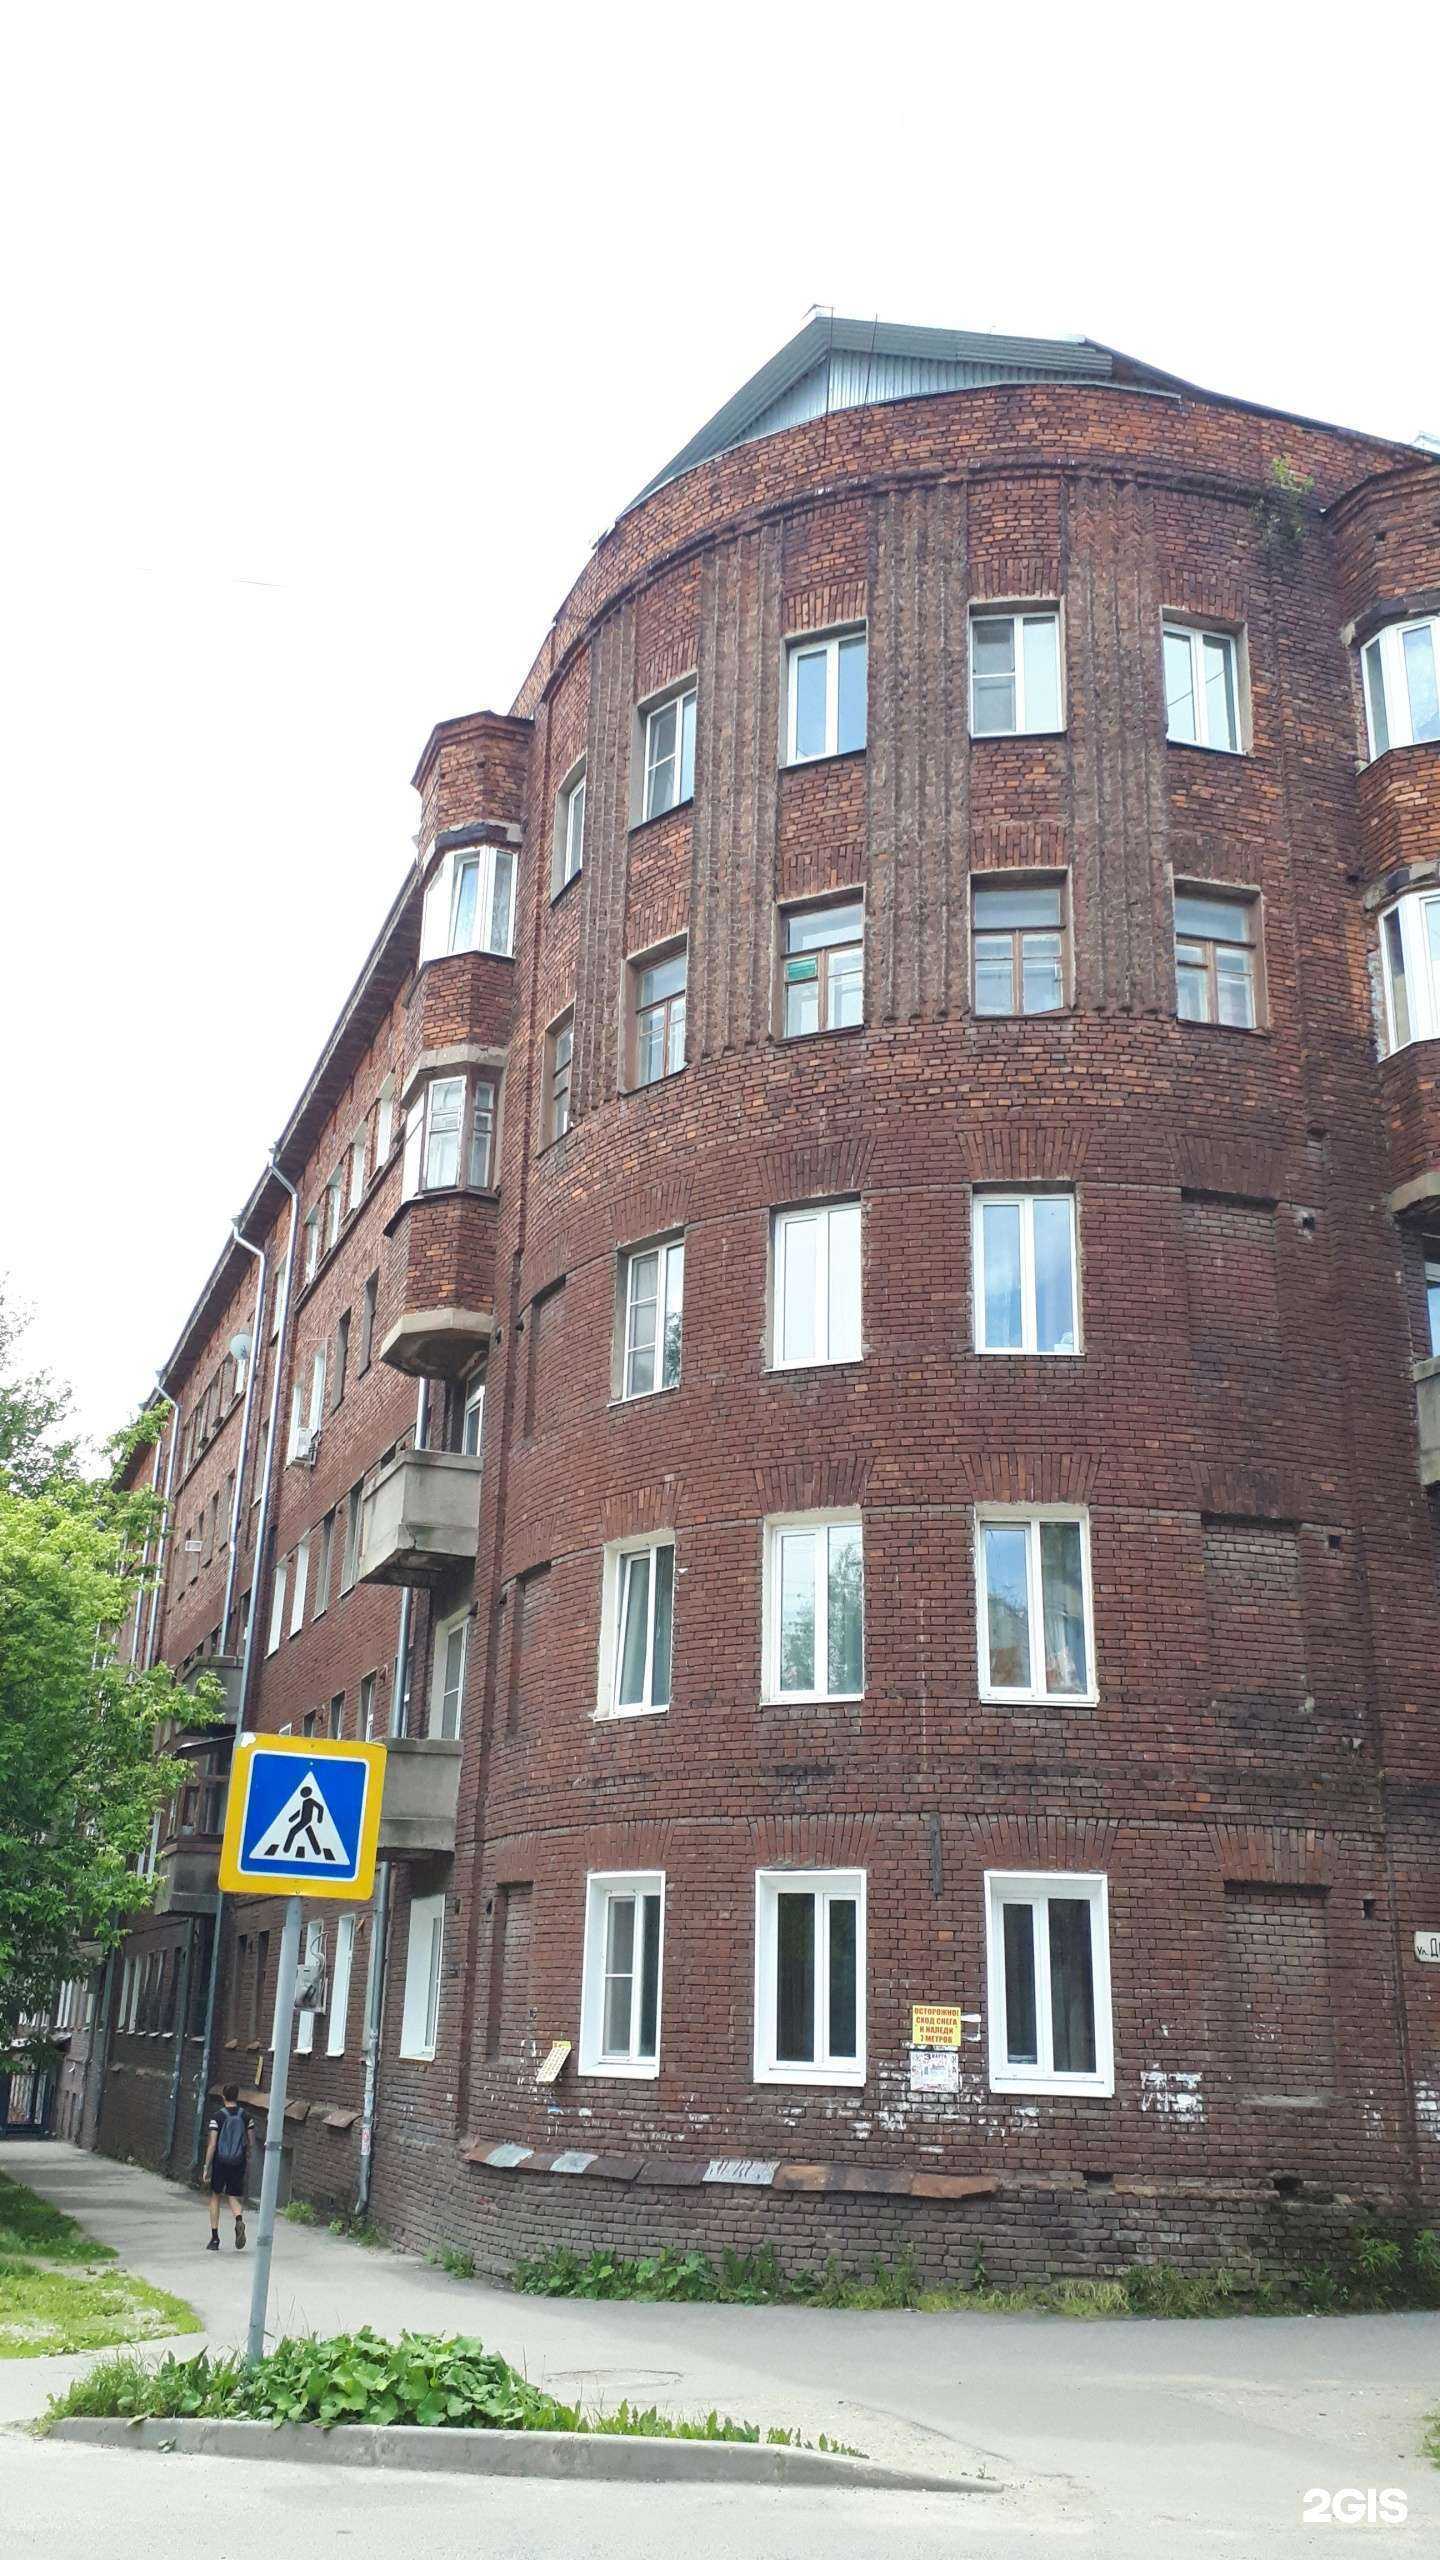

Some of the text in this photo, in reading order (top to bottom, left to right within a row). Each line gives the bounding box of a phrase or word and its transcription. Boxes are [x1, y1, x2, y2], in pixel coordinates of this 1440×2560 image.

[914, 2007, 959, 2016] ОСТОРОЖНО!
[916, 2017, 934, 2025] СХОД
[925, 2026, 953, 2035] НАЛЕДИ
[925, 2035, 952, 2043] МЕТРОВ
